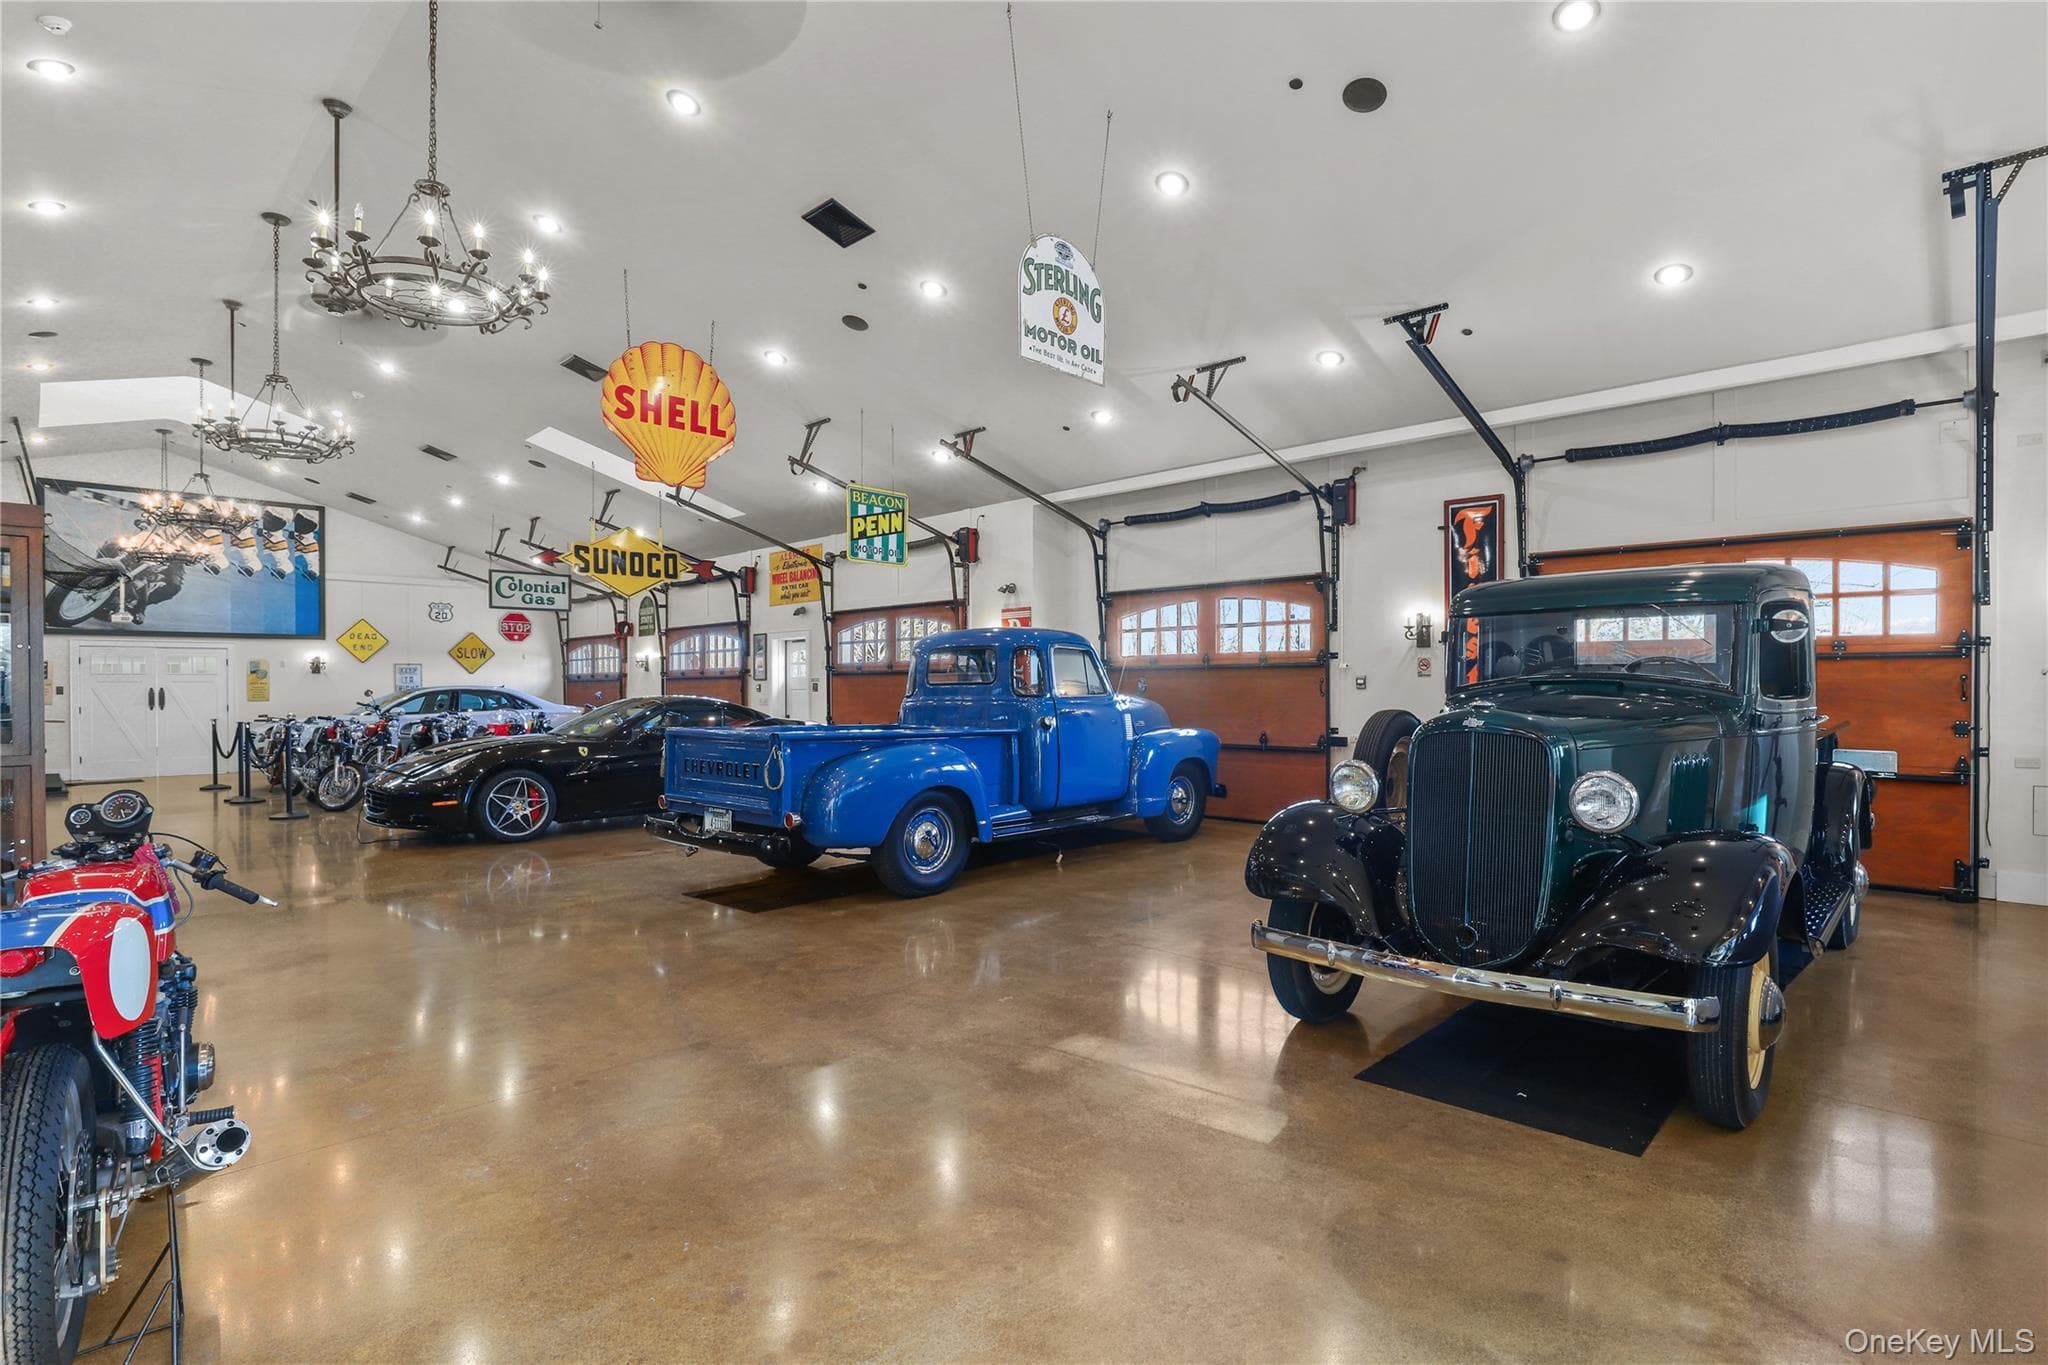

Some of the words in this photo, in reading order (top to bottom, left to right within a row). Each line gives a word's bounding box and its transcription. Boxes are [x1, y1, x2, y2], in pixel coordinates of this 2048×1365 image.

[1022, 257, 1102, 324] STERLING
[1024, 323, 1077, 357] MOTOR
[1081, 344, 1102, 365] OIL
[614, 384, 727, 439] SHELL
[852, 490, 903, 509] BEACON
[852, 511, 903, 539] PENN
[854, 543, 883, 556] MOTOR
[888, 548, 901, 559] OIL
[573, 544, 679, 580] SUNOCO
[495, 576, 566, 599] Colonial
[521, 593, 556, 606] Gas
[434, 612, 448, 620] 20
[349, 632, 377, 641] DEAD
[501, 622, 531, 633] STOP
[352, 644, 374, 652] END
[456, 647, 488, 660] SLOW
[684, 758, 760, 780] CHEVROLET
